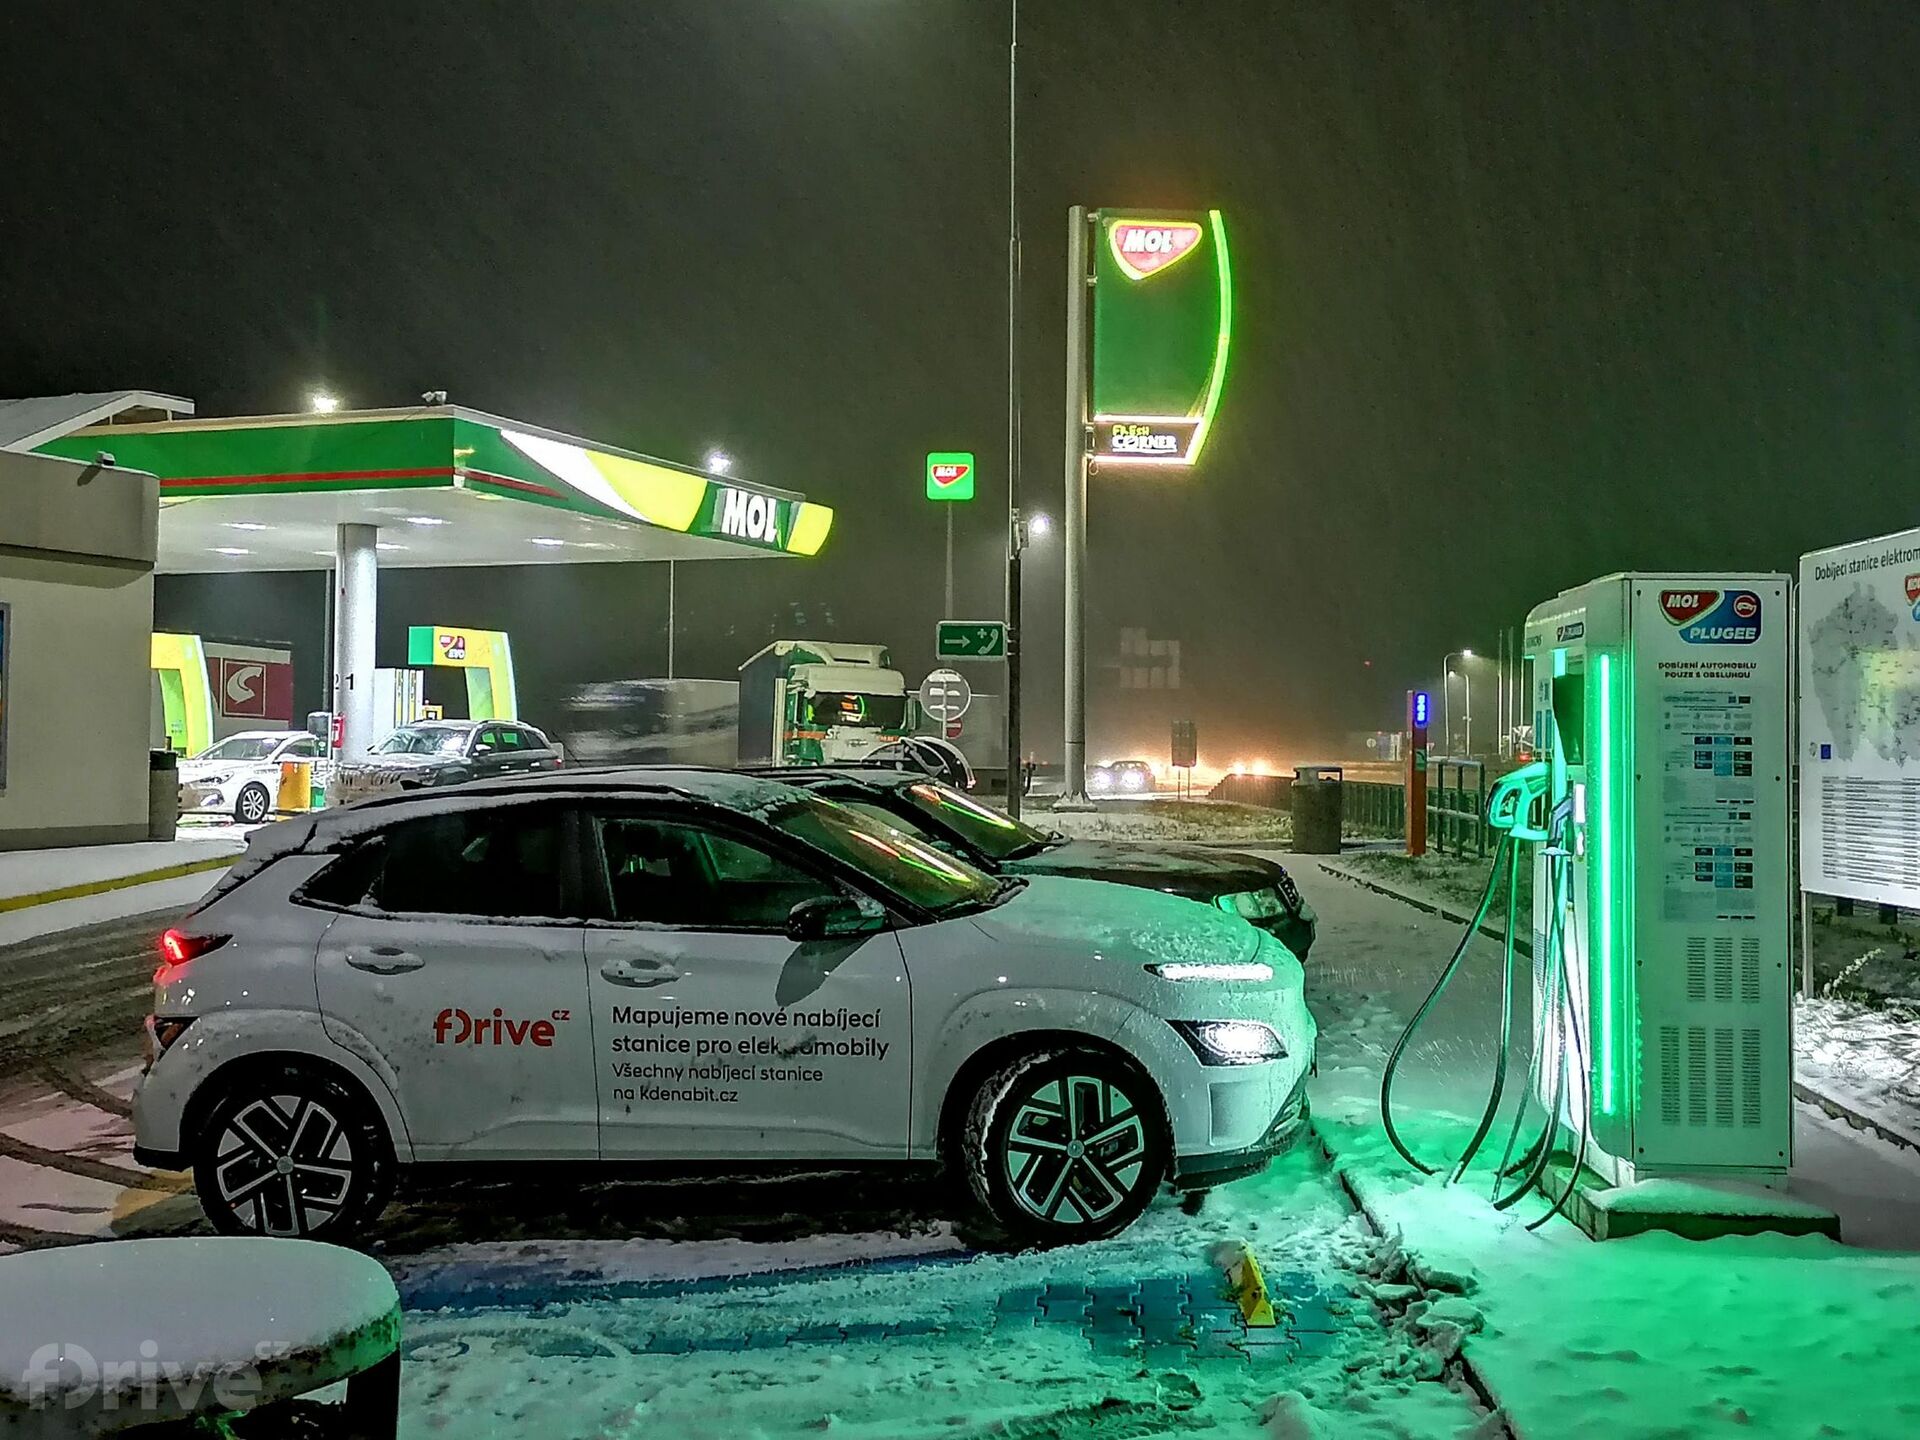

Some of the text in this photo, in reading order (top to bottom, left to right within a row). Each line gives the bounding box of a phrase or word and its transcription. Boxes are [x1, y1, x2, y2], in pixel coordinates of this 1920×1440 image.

[1122, 229, 1173, 253] MOL
[1112, 424, 1150, 436] FRESH
[935, 466, 958, 477] MOL
[721, 487, 778, 543] MOL
[1849, 554, 1879, 574] stanice
[1666, 594, 1700, 608] MOL
[1690, 627, 1757, 640] PLUGEE
[612, 1006, 881, 1032] Mapujeme nové nabíjecí
[611, 1034, 690, 1053] stanice
[697, 1040, 732, 1057] pro
[612, 1062, 823, 1083] Všechny nabíjecí stanice
[613, 1085, 738, 1102] na kdenabit.cz
